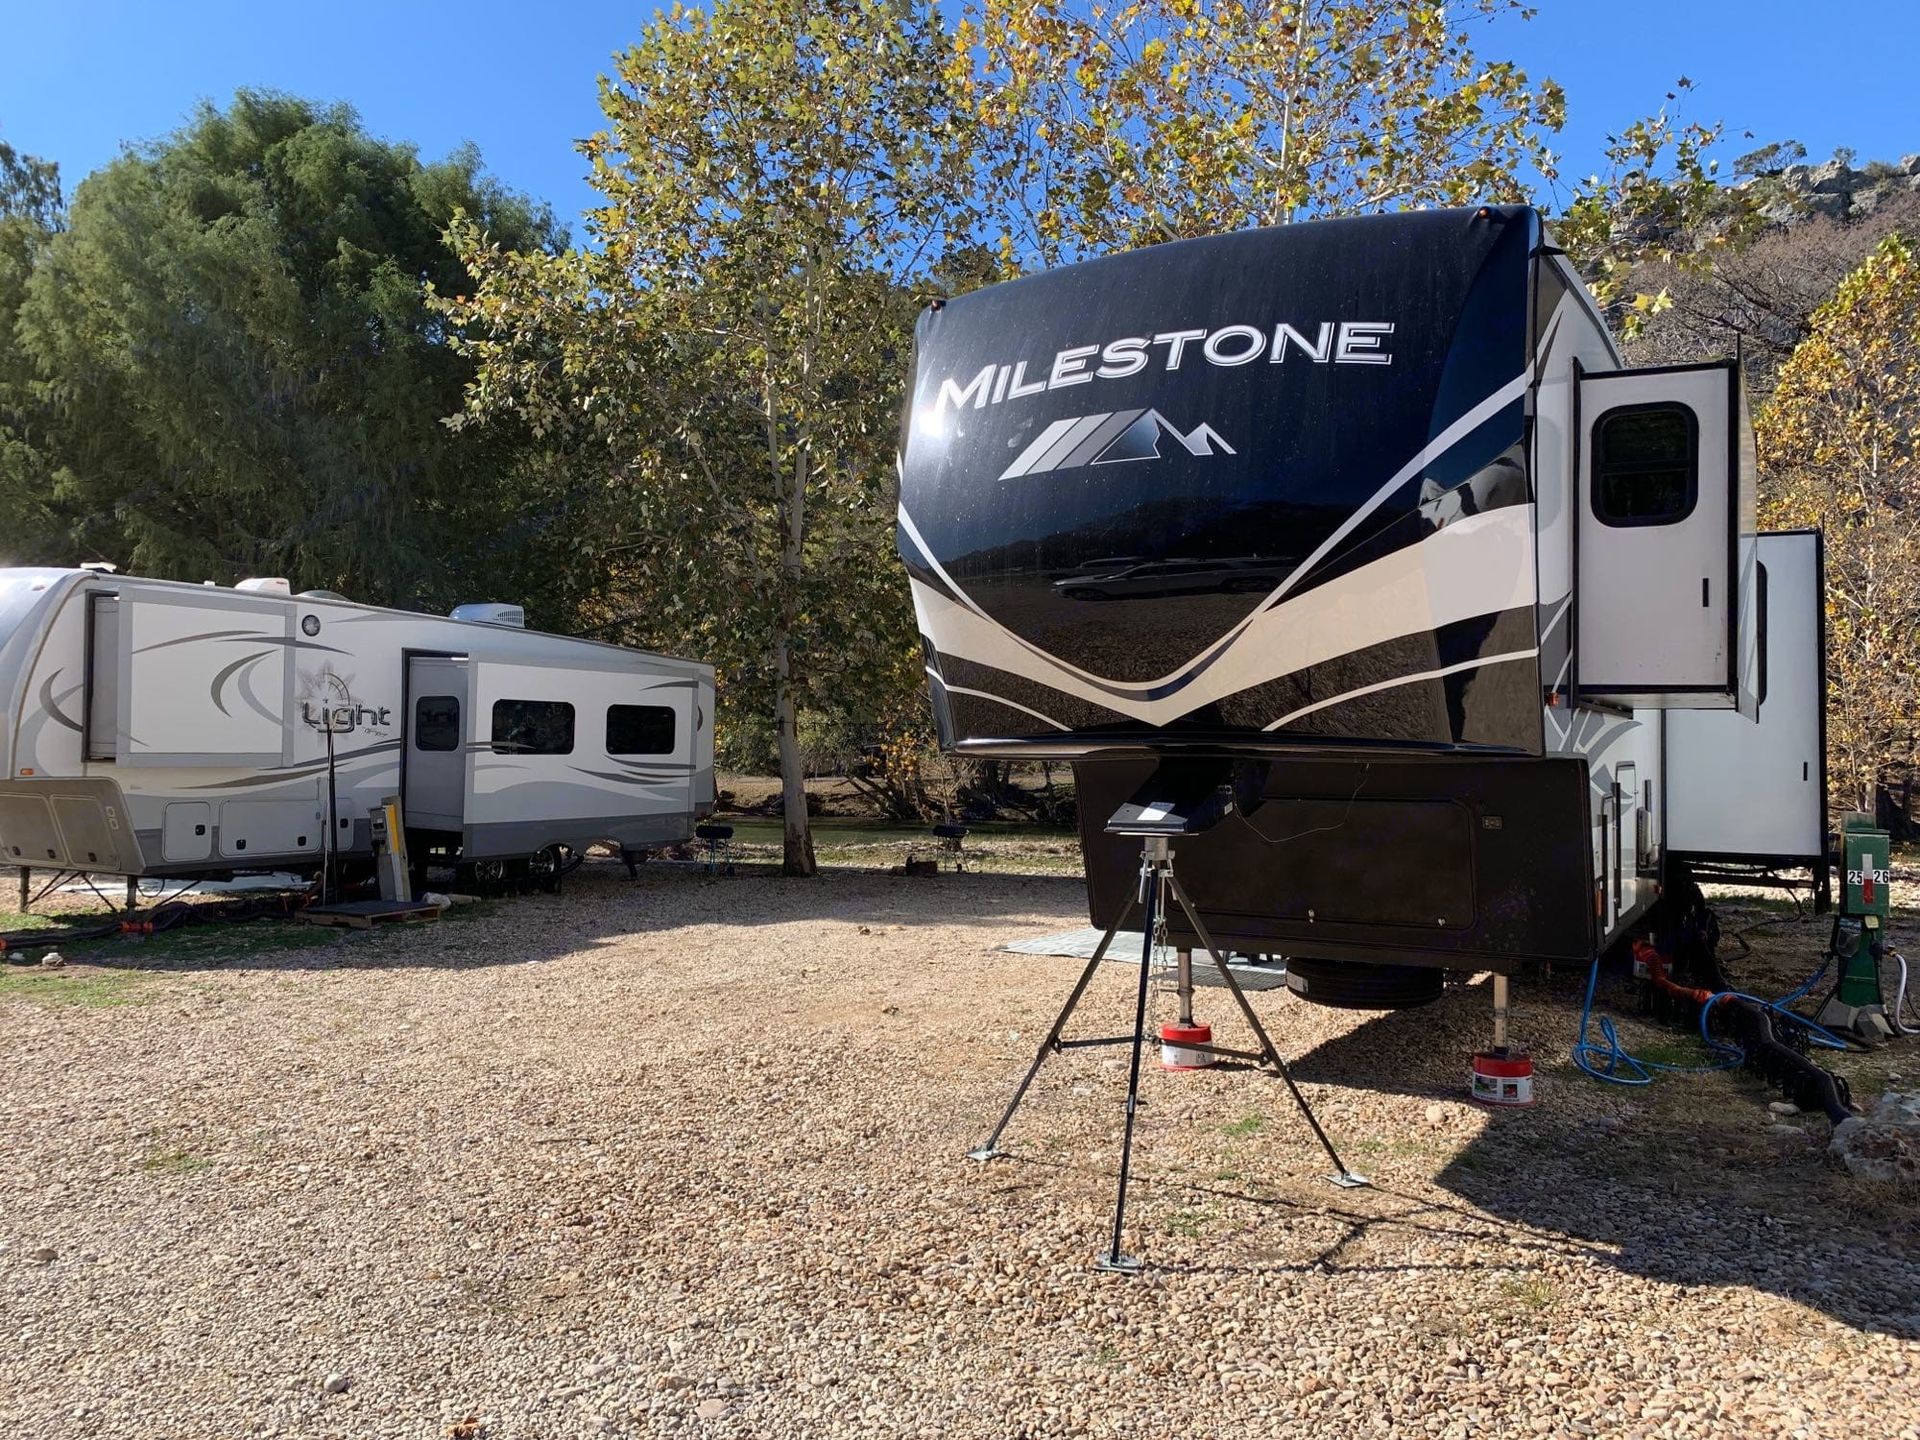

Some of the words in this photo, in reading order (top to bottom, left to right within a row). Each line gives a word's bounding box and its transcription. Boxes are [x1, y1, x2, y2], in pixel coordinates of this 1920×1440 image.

[934, 321, 1395, 411] MILESTONE
[1849, 871, 1863, 884] 25
[1873, 870, 1889, 883] 26
